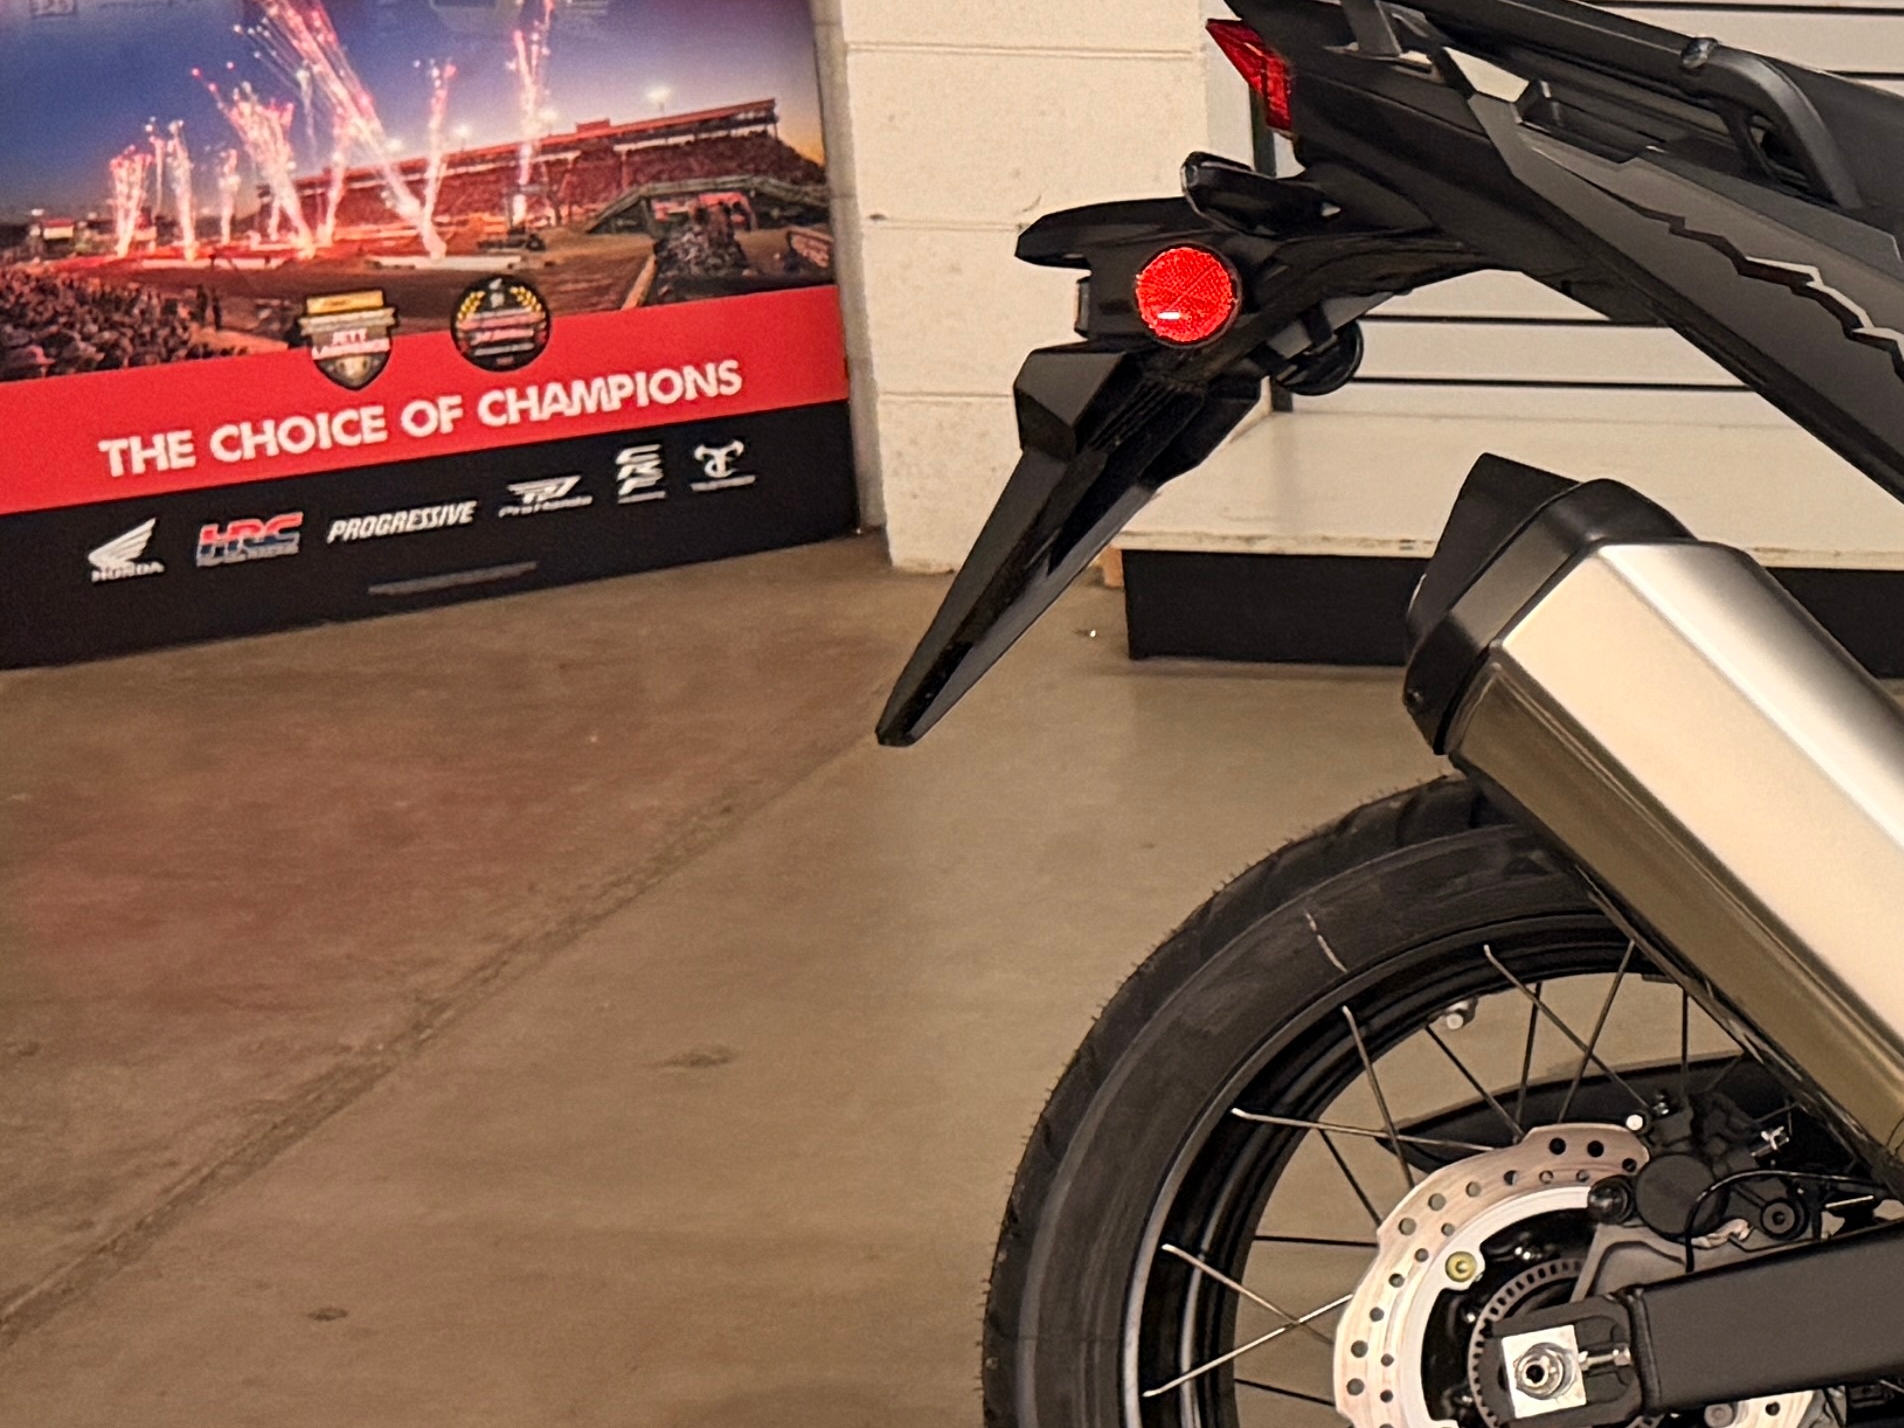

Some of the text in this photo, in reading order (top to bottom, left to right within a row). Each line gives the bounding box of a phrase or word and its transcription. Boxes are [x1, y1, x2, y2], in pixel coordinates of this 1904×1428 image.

[98, 359, 743, 477] THE CHOICE OF CHAMPIONS
[327, 500, 477, 544] PROGRESSIVE
